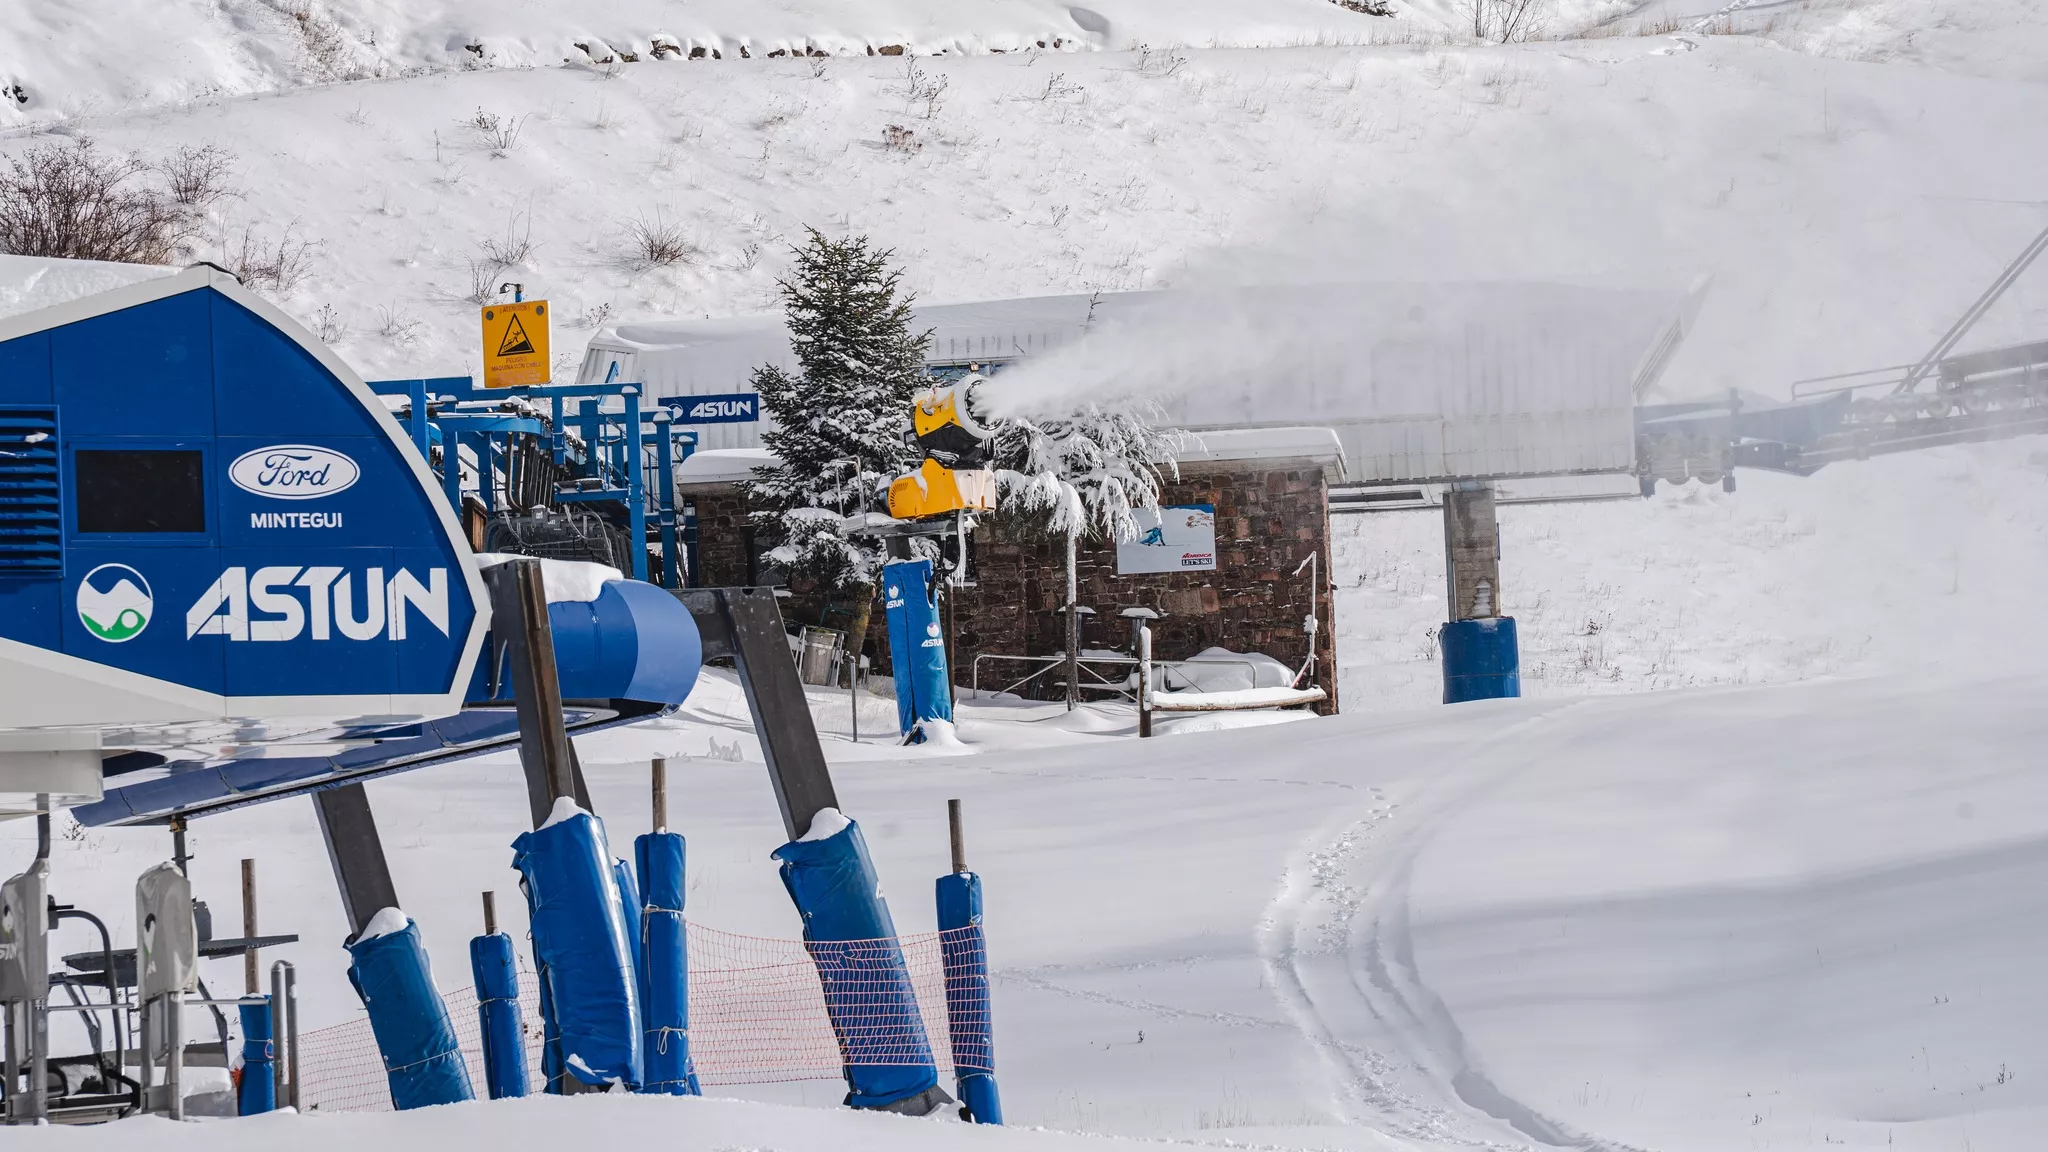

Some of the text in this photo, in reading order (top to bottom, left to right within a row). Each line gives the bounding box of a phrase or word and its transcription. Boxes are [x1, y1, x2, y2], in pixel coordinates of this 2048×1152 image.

[689, 401, 752, 417] ASTUN
[258, 453, 331, 486] Ford
[251, 512, 342, 528] MINTEGUI
[186, 566, 449, 641] ASTUN
